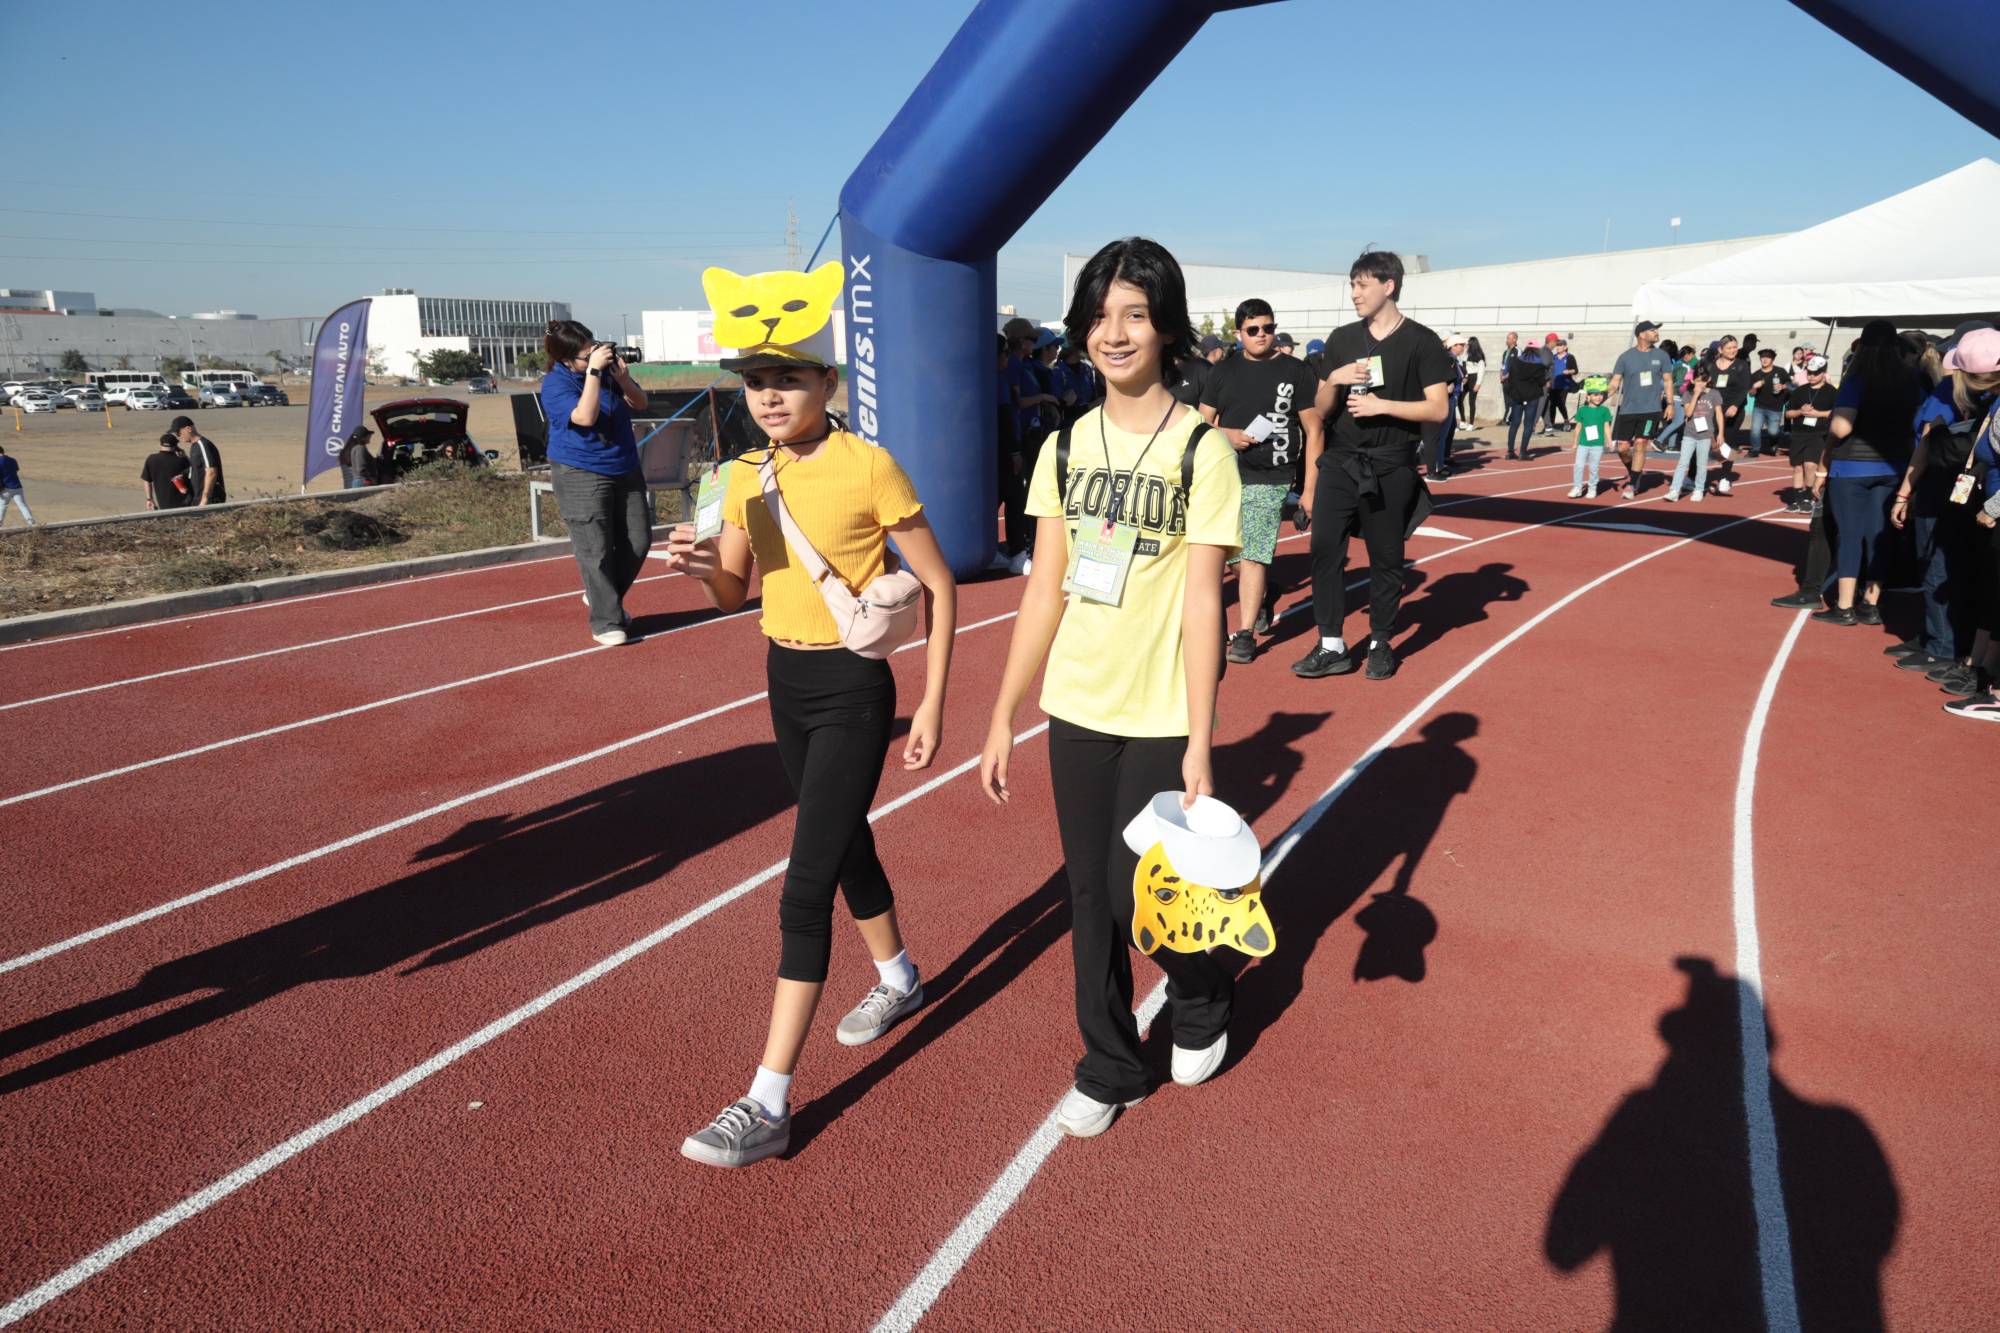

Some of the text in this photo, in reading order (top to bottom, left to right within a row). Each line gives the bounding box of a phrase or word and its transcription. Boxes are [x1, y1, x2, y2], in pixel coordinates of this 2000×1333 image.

[331, 322, 350, 433] CHANGAN AUTO
[1065, 467, 1186, 536] LORIDA
[1136, 542, 1158, 553] ATE
